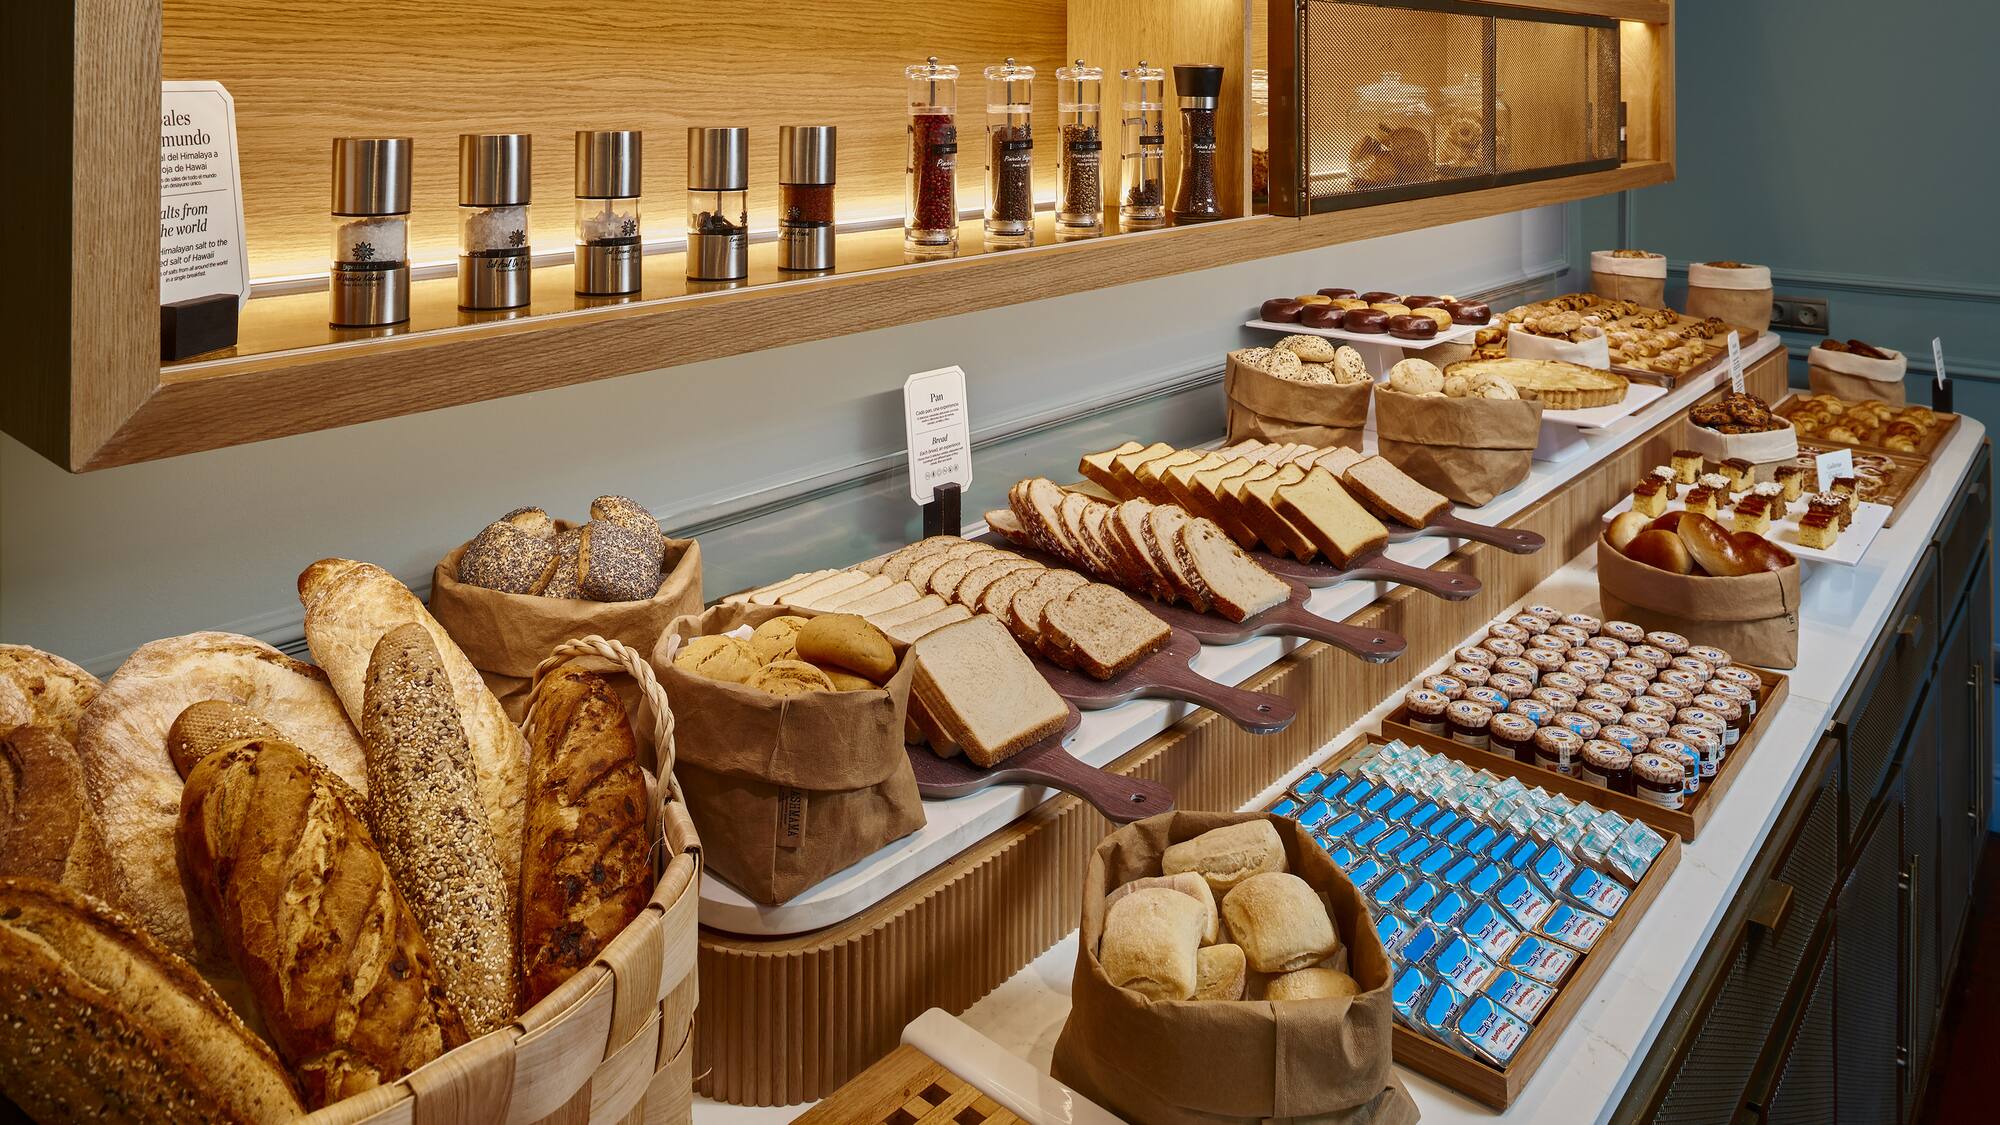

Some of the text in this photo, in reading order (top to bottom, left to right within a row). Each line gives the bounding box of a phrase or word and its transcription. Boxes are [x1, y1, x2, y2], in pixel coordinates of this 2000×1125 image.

[160, 110, 191, 126] ales
[162, 129, 211, 147] mundo
[167, 152, 179, 161] del
[180, 151, 213, 160] Himalaya
[161, 165, 173, 174] oja
[174, 164, 185, 173] de
[160, 203, 208, 220] alts from
[160, 218, 208, 238] he world
[195, 241, 207, 251] salt
[208, 240, 216, 248] to
[216, 239, 228, 247] the
[160, 258, 168, 267] ed
[169, 256, 182, 266] salt
[183, 254, 192, 263] of
[930, 393, 944, 402] Pan
[932, 433, 948, 445] Bread
[788, 790, 801, 837] ASHMAMA
